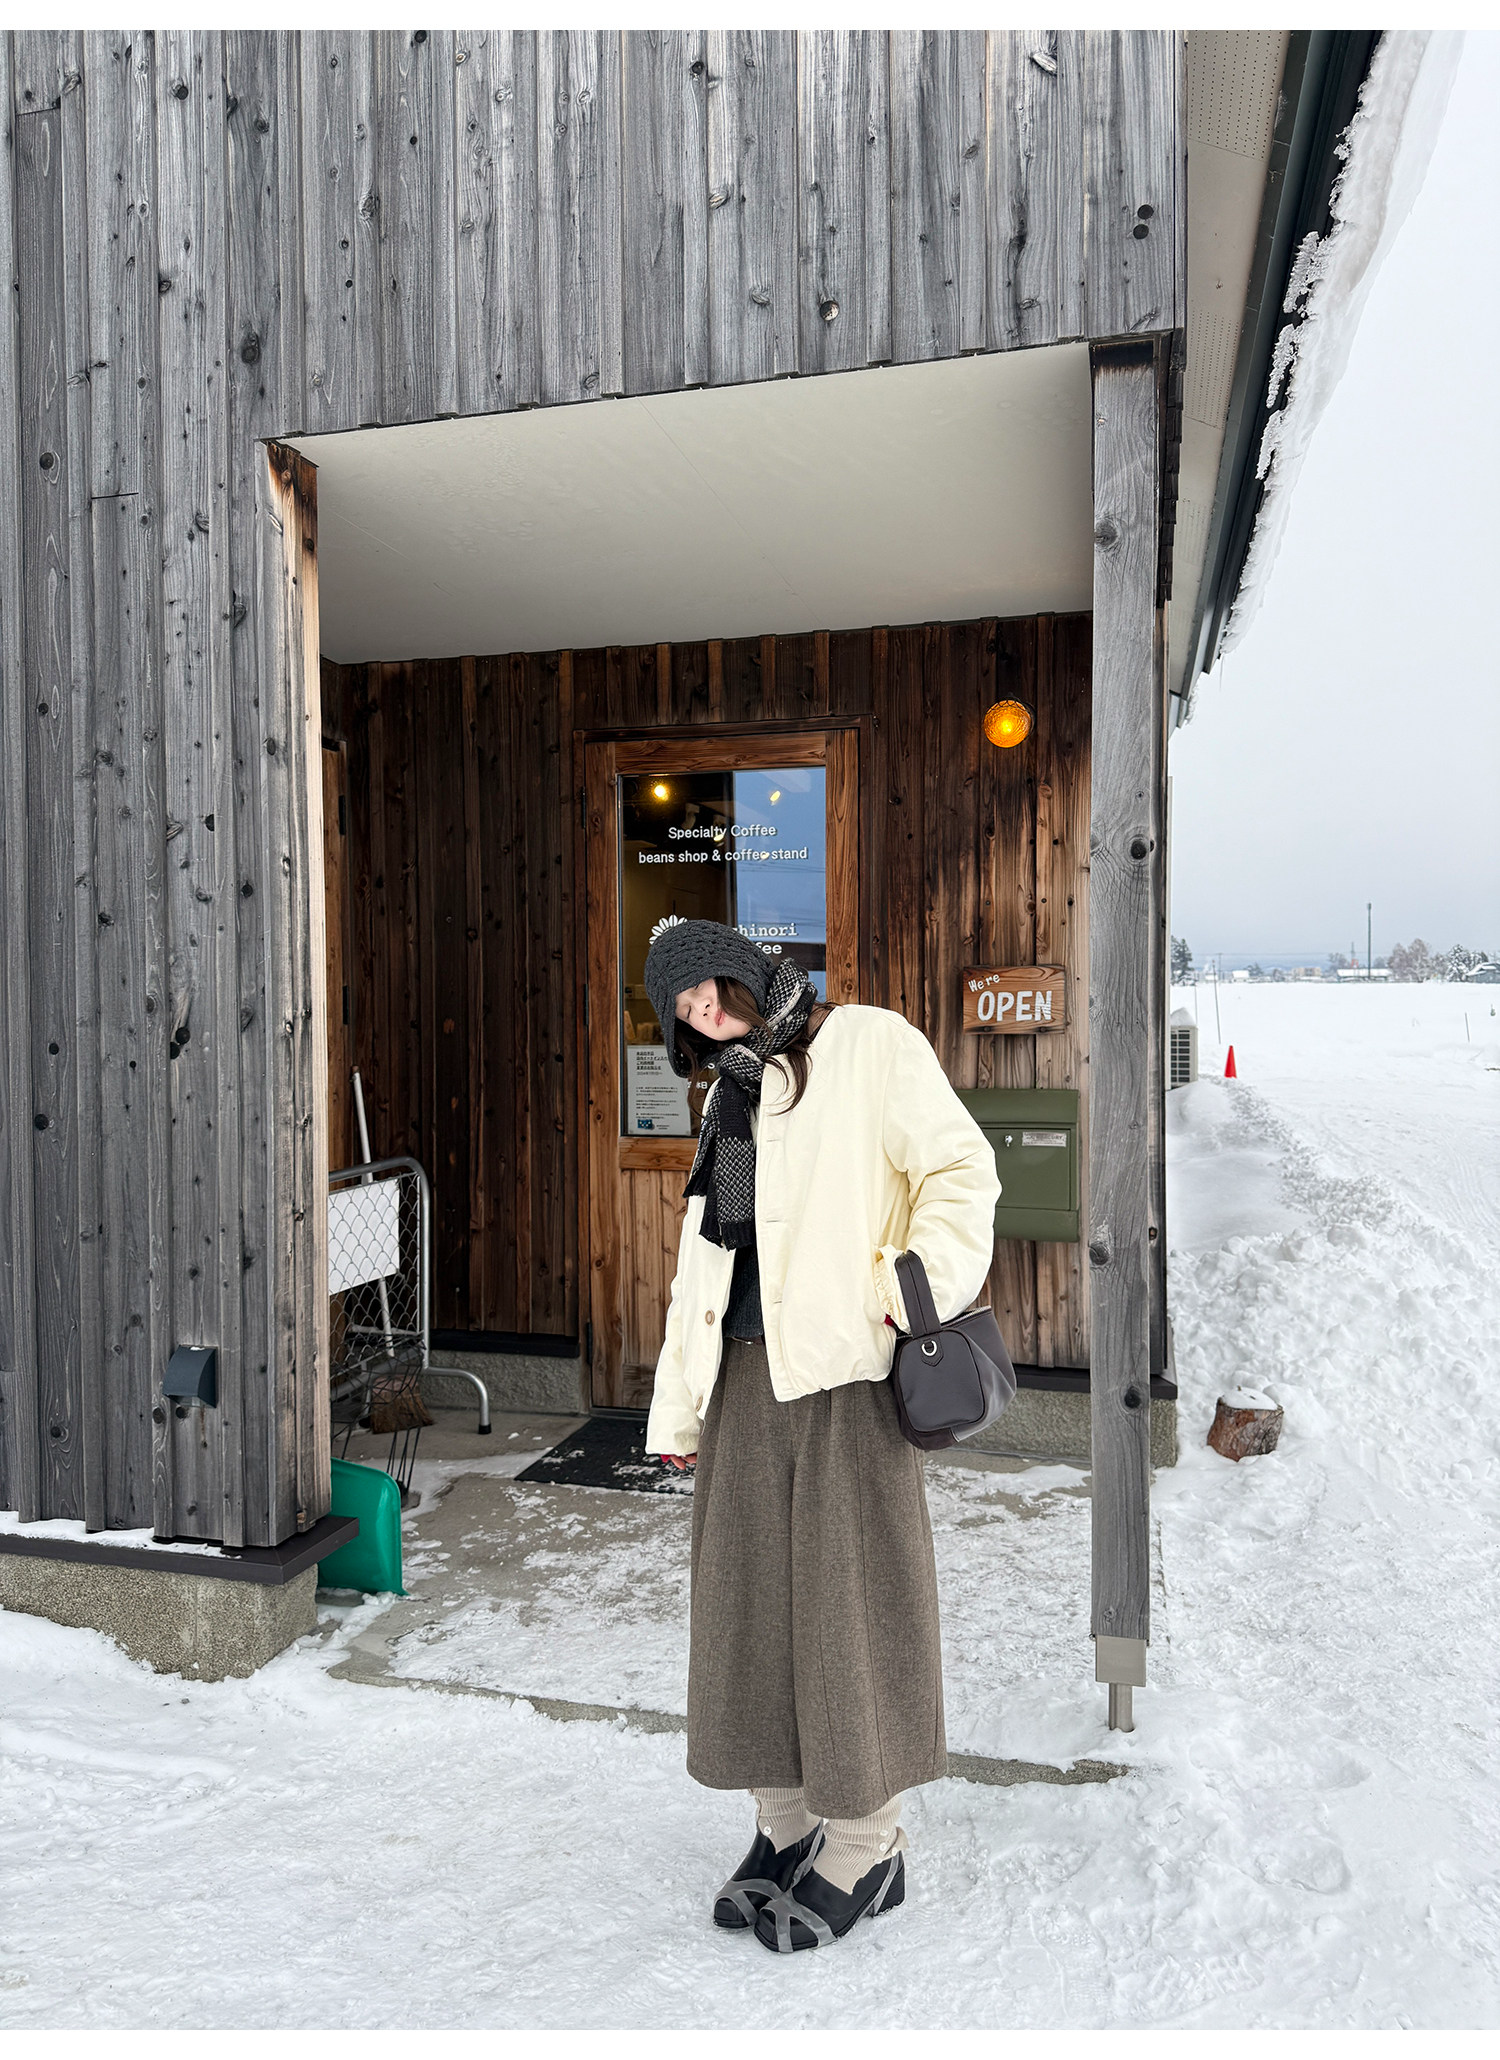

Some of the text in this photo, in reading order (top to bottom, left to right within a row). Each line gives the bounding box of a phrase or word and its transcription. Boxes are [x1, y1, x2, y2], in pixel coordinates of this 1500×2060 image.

[668, 824, 777, 841] Specialty Coffee
[638, 851, 675, 865] beans
[678, 850, 708, 864] shop
[711, 849, 721, 862] &
[771, 846, 808, 861] stand
[977, 990, 1053, 1022] OPEN
